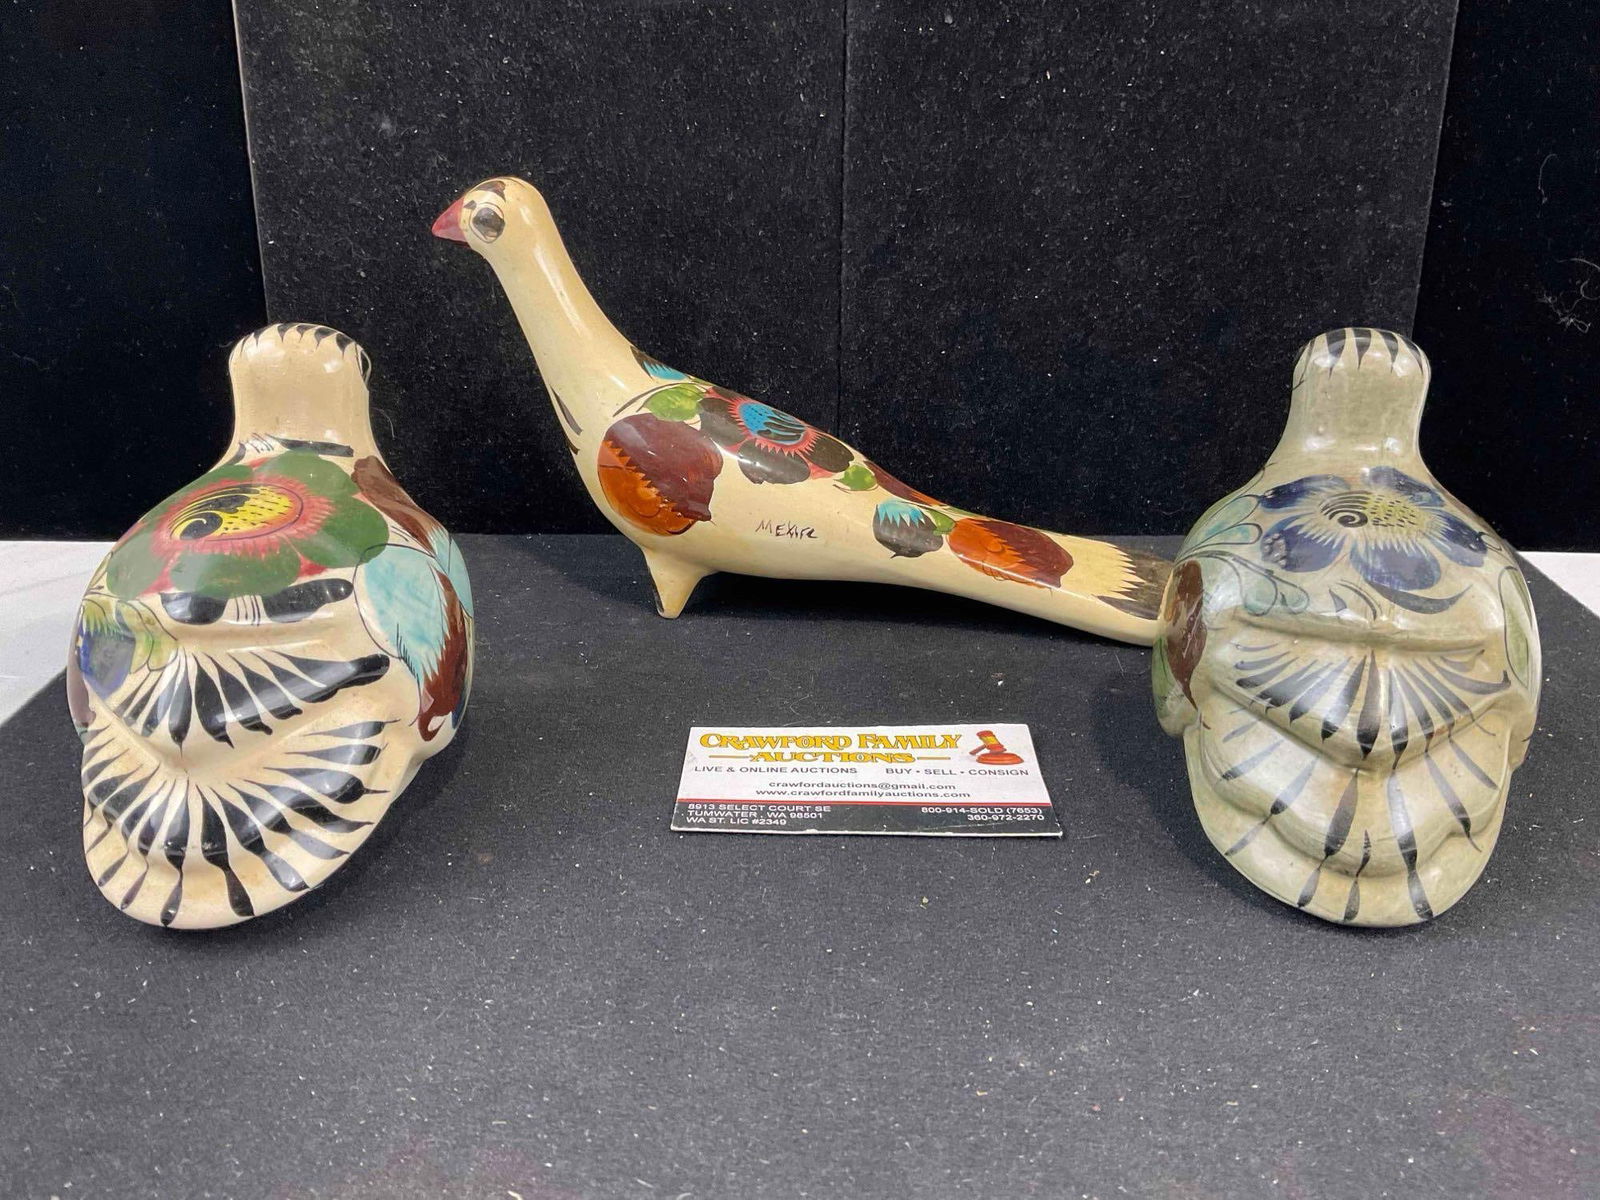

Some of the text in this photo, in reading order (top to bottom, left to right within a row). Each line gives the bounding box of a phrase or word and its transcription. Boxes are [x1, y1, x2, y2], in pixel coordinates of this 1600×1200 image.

[700, 733, 962, 750] CRAWFORD FAMILY
[750, 752, 916, 763] AUCTIONS
[769, 781, 956, 790] crawfordauctions@gmail.com
[756, 788, 970, 798] www.crawfordfamilyauctions.com
